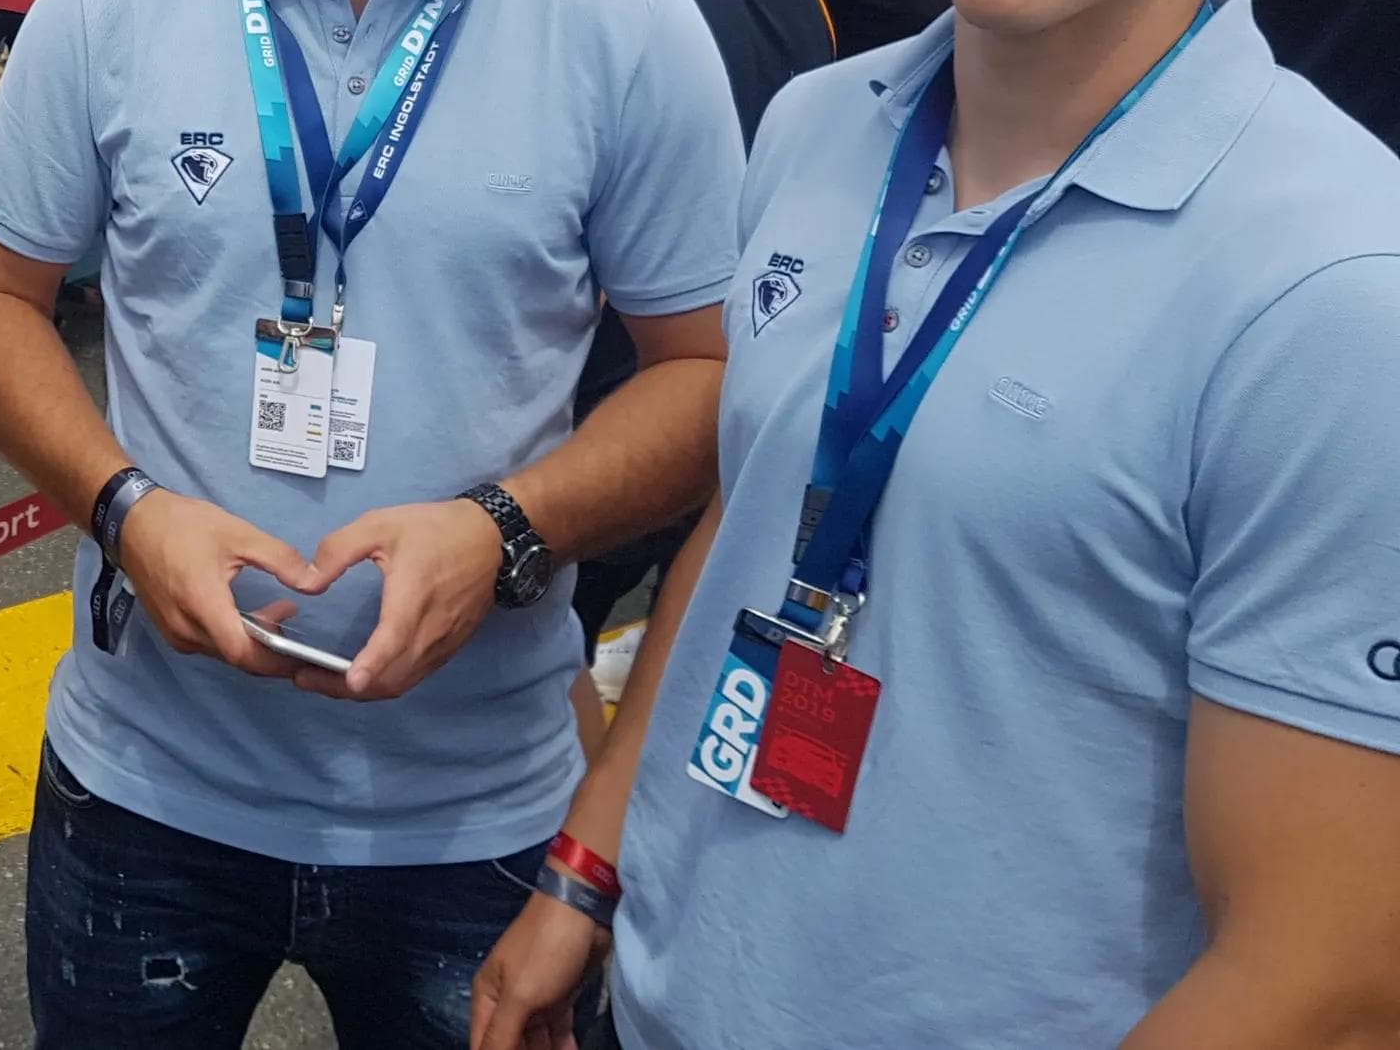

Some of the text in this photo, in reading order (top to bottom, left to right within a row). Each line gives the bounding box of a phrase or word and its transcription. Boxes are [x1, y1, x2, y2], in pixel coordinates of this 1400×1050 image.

[259, 35, 276, 69] GRID
[393, 54, 416, 88] GRID
[372, 40, 441, 180] ERC INGOLSTADT
[180, 131, 224, 147] ERC
[767, 251, 805, 275] ERC
[783, 669, 835, 704] DTM
[700, 667, 766, 784] GRD
